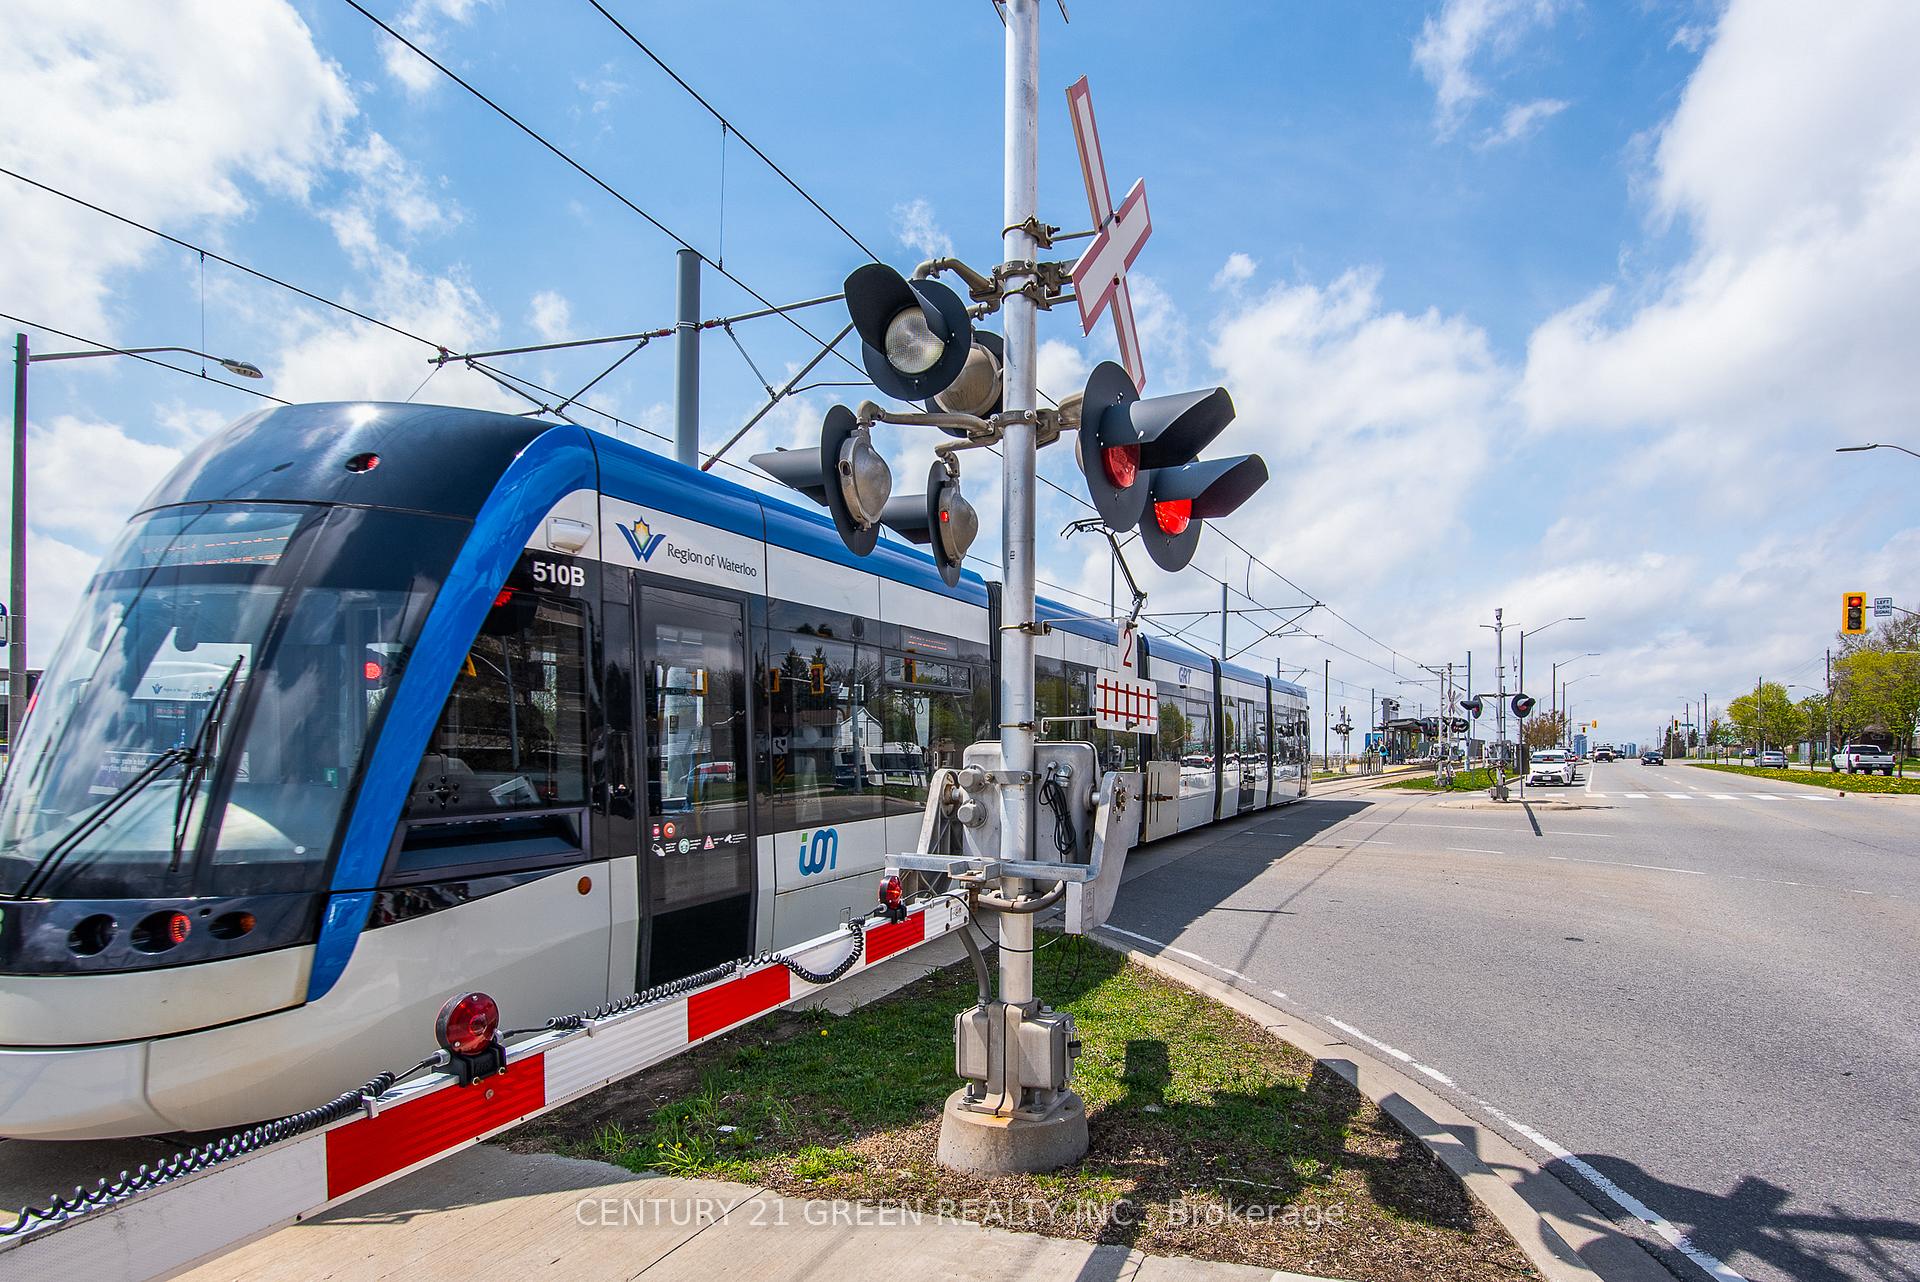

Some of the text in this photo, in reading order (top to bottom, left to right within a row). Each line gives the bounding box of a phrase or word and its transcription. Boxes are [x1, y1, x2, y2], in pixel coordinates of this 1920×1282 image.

[533, 561, 585, 587] 510B
[667, 543, 757, 577] Region of Waterloo
[1123, 627, 1132, 668] 2
[1179, 666, 1192, 685] GRT
